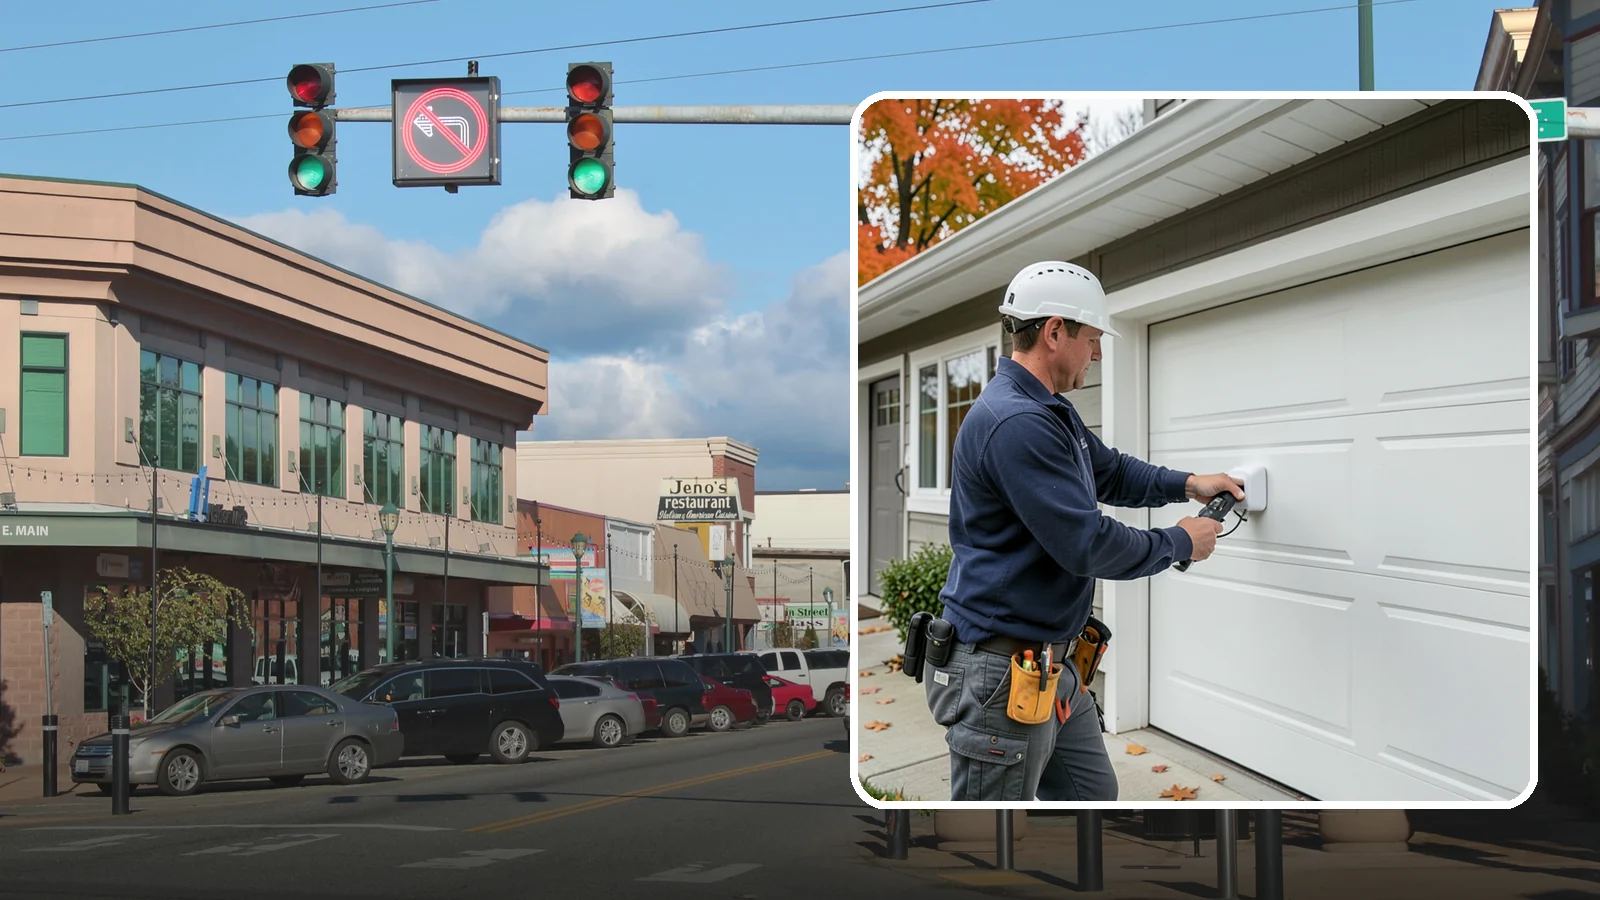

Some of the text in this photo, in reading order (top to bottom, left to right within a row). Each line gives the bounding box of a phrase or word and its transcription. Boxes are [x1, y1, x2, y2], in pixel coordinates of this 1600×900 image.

[669, 480, 728, 495] Jeno's
[665, 496, 731, 509] restaurant
[658, 510, 682, 520] Italian
[686, 510, 714, 520] American
[715, 509, 738, 520] Cuisine
[2, 525, 49, 536] E. MAIN
[797, 607, 828, 617] Street
[790, 619, 824, 627] lass
